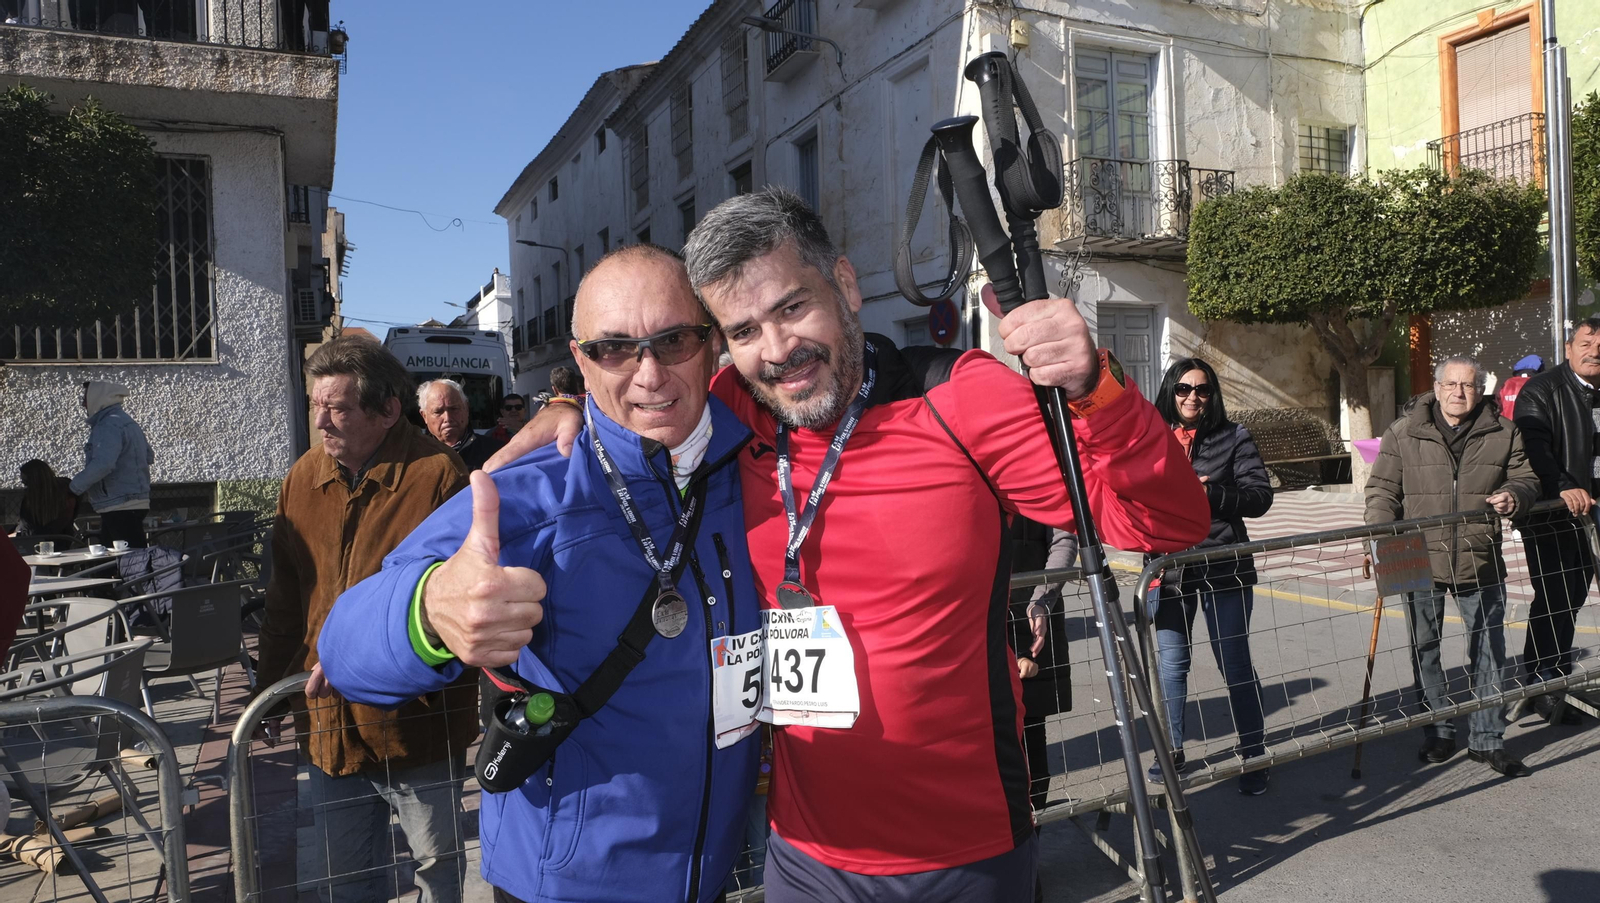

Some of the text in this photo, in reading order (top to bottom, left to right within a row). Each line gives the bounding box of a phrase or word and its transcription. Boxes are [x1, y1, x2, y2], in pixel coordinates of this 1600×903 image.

[406, 356, 490, 369] AMBULANCIA
[771, 612, 795, 624] CxM
[770, 626, 809, 639] PÓLVORA
[732, 636, 746, 651] IV
[727, 654, 743, 666] LA
[771, 649, 826, 693] 437
[742, 666, 764, 708] 5
